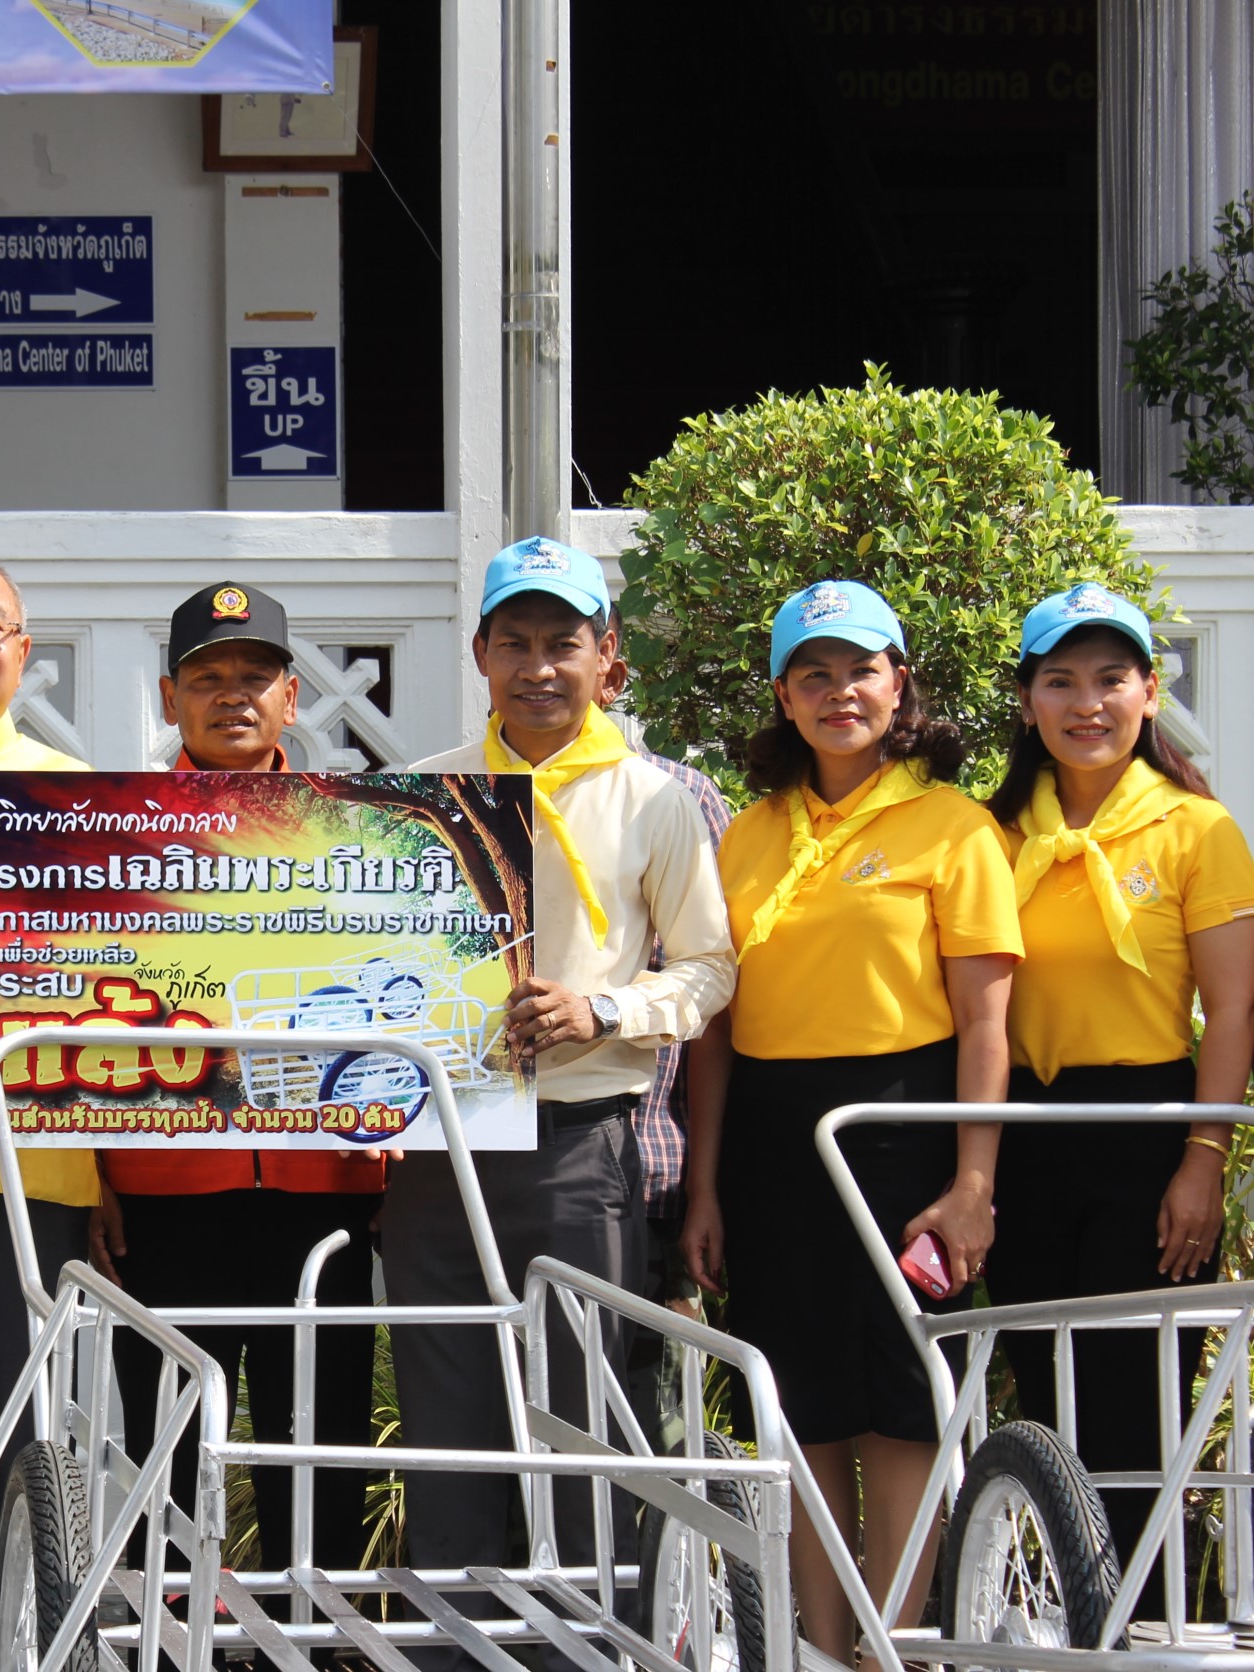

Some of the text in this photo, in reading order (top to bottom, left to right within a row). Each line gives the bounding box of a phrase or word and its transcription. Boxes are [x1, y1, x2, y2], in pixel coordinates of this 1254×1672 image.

[837, 60, 1031, 109] ongdhama
[18, 340, 69, 373] Center
[75, 340, 91, 373] of
[96, 341, 149, 373] Phuket
[241, 349, 326, 406] ขึ้น
[264, 414, 304, 437] UP
[133, 960, 185, 981] จังหวัด
[165, 964, 226, 1011] ภูเก็ต
[232, 1104, 313, 1129] จำนวน
[322, 1106, 358, 1129] 20
[363, 1105, 401, 1129] คัน
